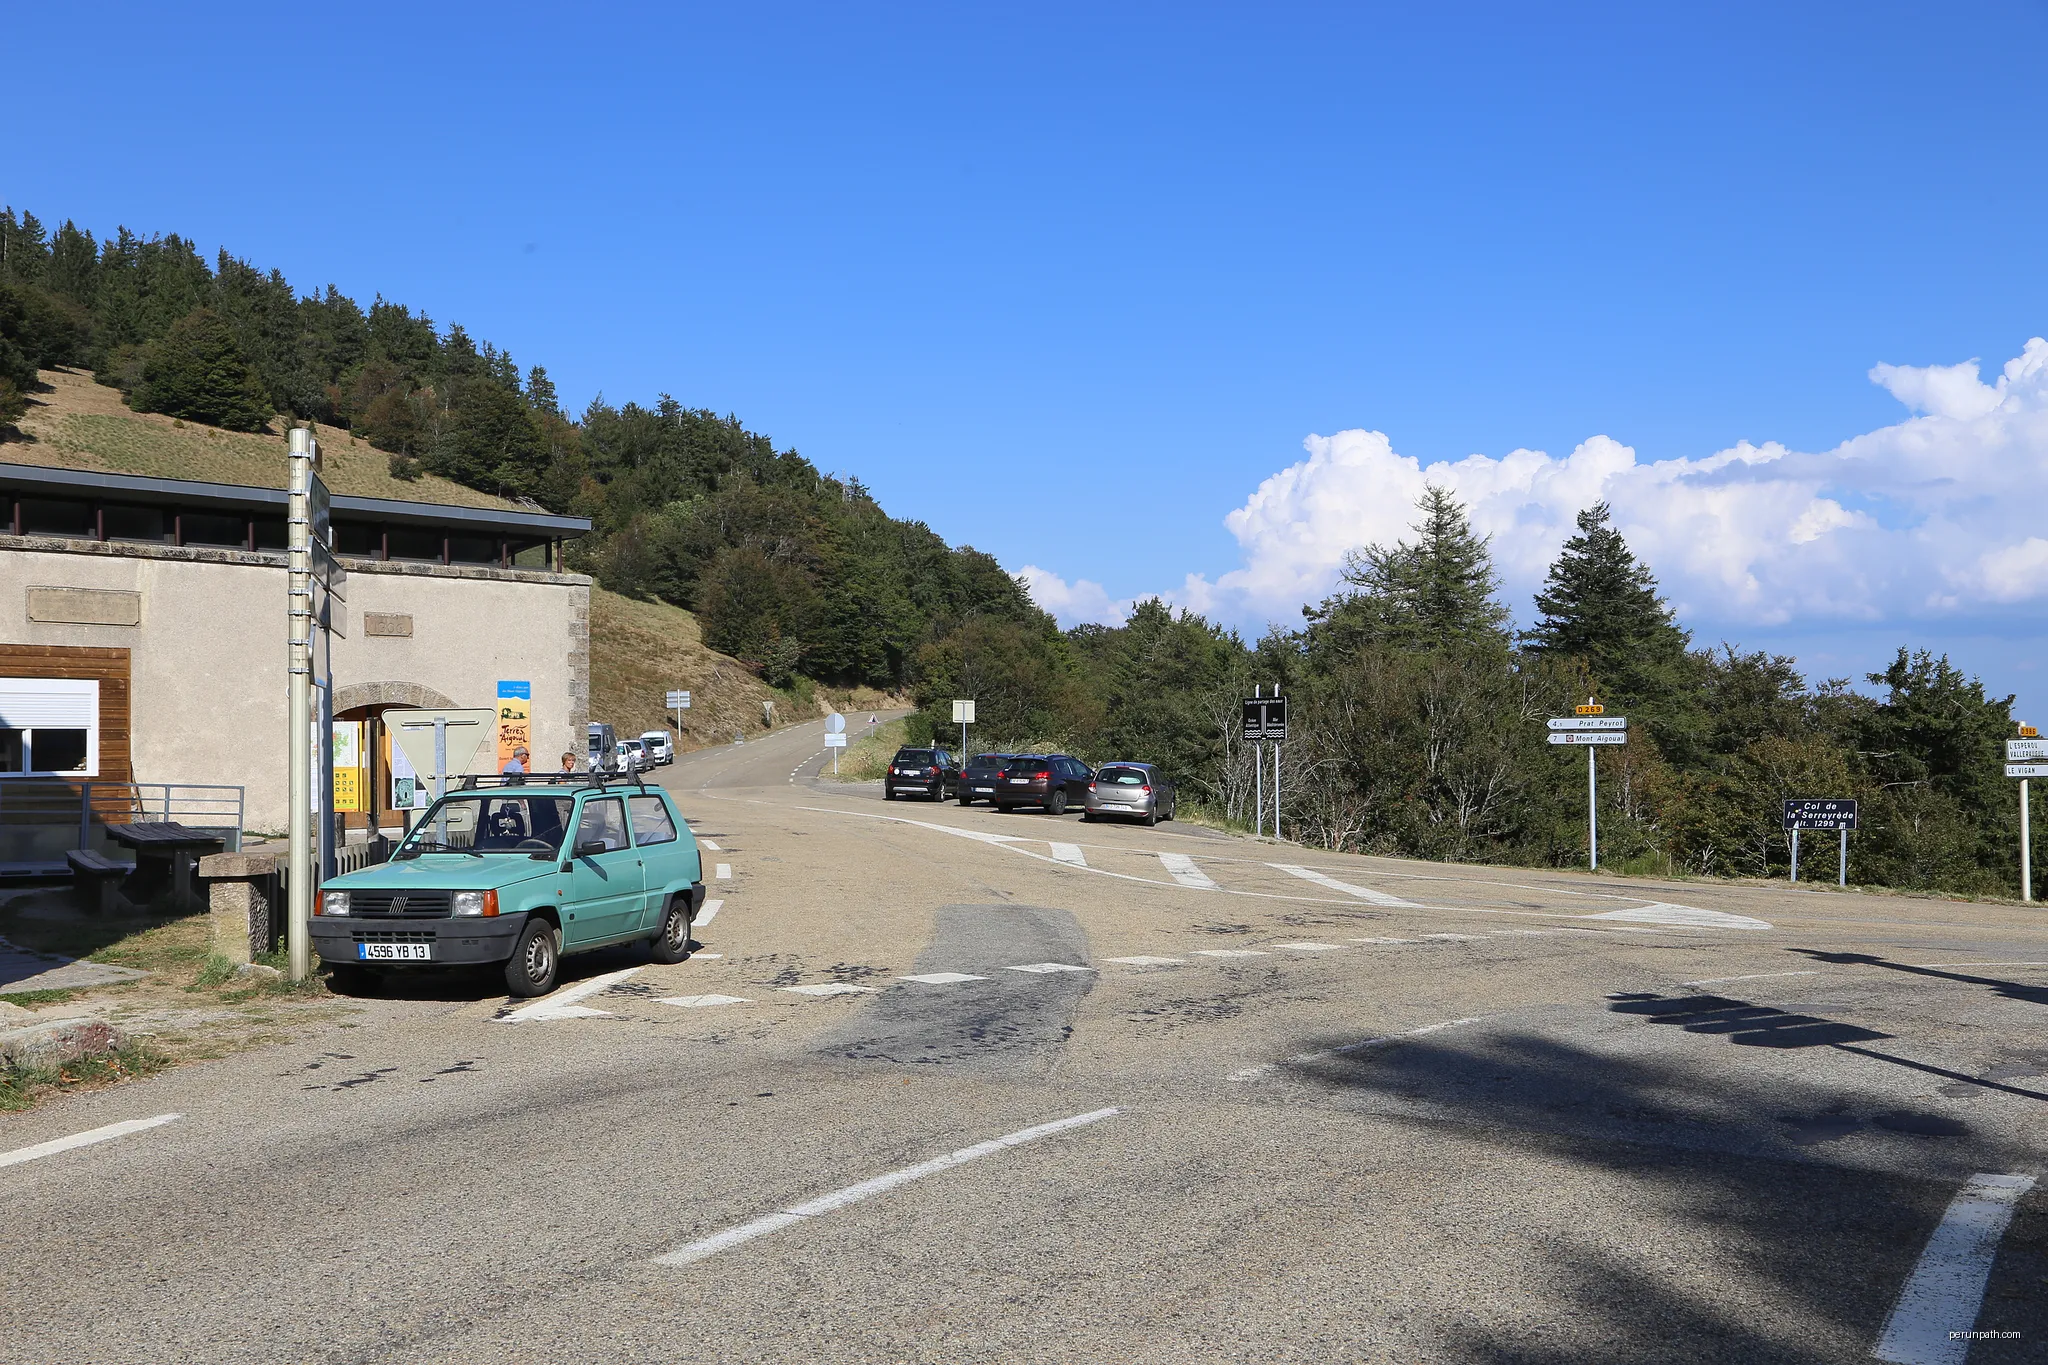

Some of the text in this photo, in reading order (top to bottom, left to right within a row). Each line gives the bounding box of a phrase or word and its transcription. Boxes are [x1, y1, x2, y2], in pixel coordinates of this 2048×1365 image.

[1599, 719, 1623, 728] Peyrot
[1597, 735, 1624, 743] Aigoual
[1804, 802, 1837, 810] Col de
[1787, 811, 1854, 821] la Serreyrède
[1814, 820, 1835, 828] 1299
[367, 945, 426, 959] 4596 YB 13
